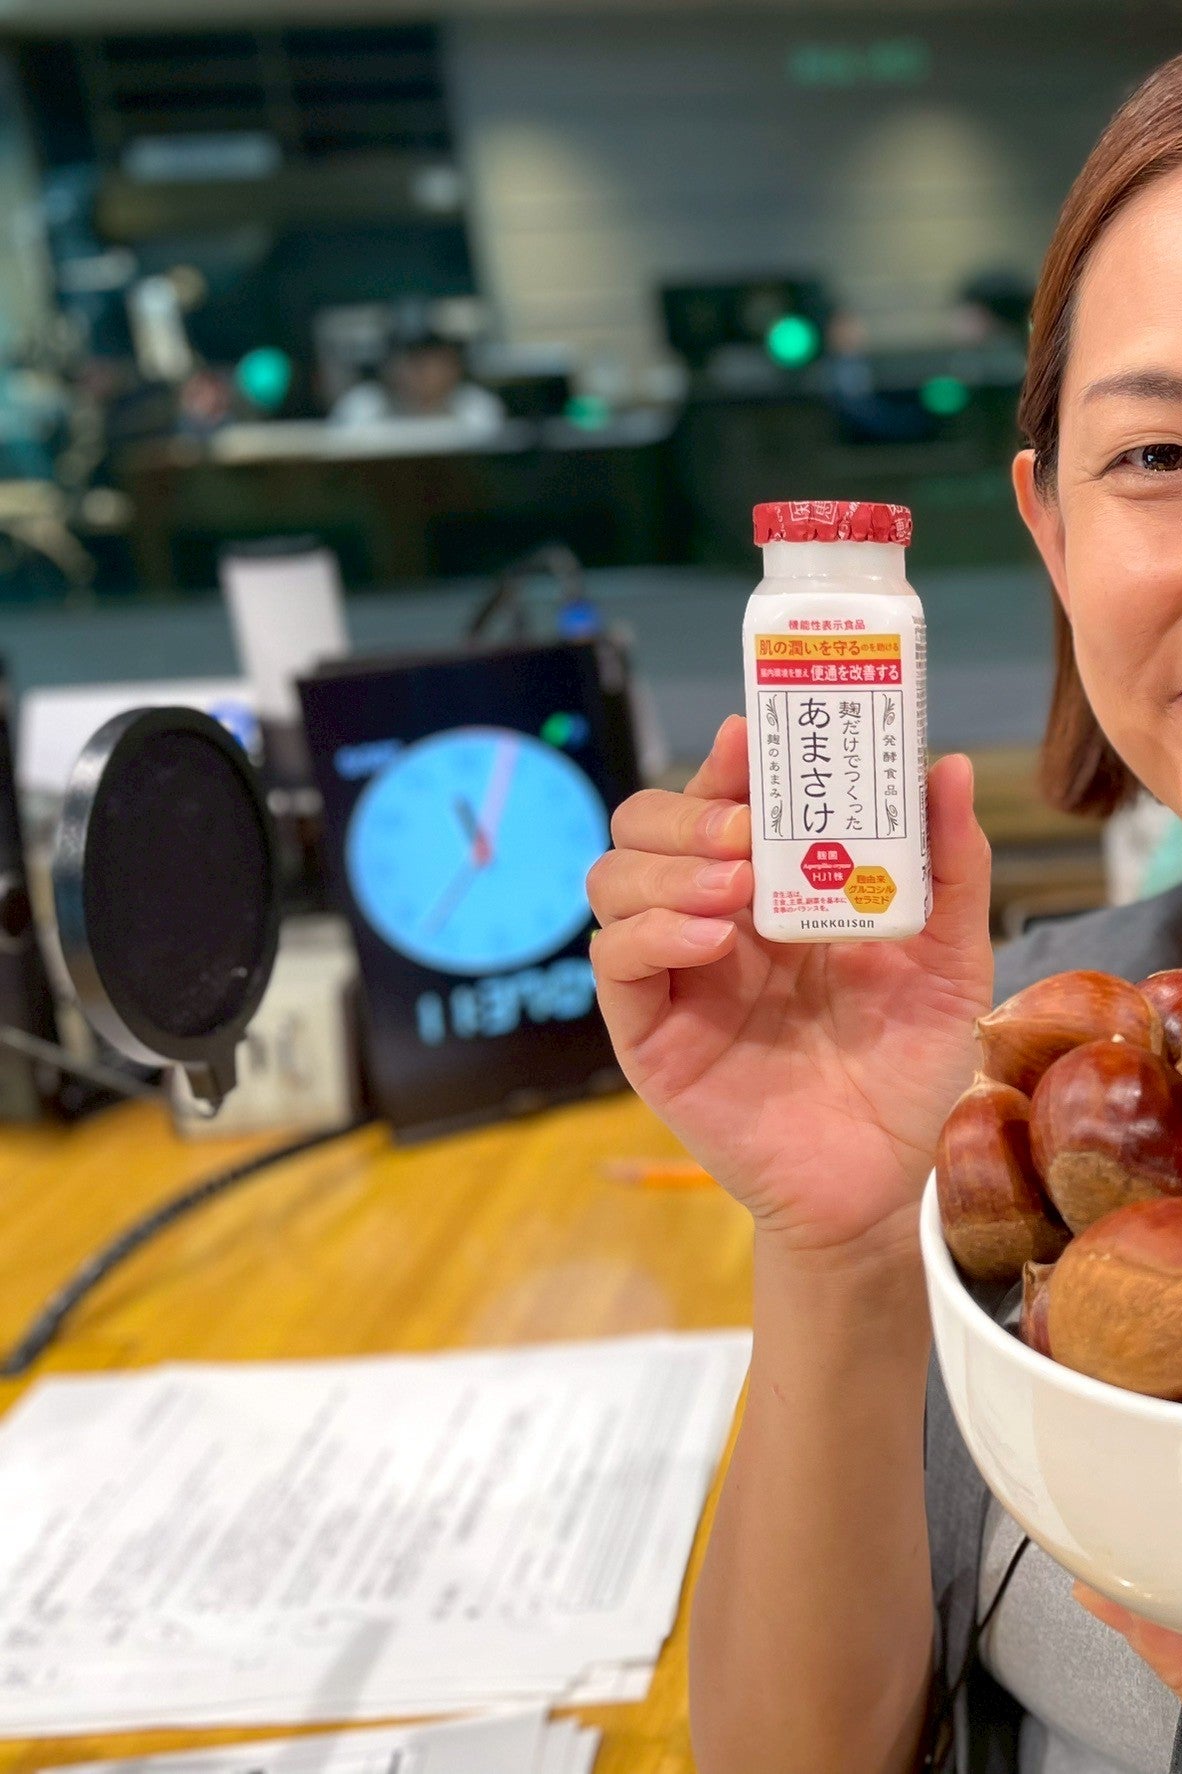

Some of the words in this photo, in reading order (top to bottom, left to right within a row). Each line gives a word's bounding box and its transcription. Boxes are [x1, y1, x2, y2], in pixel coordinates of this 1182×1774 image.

[788, 619, 866, 631] 機能性表示食品
[798, 697, 835, 834] あまさけ
[838, 701, 863, 831] 麹だけでつくった
[882, 734, 898, 796] 発酵食品
[848, 885, 895, 895] グルコシル
[853, 895, 890, 905] セラミド
[800, 919, 875, 930] Hakkaisan
